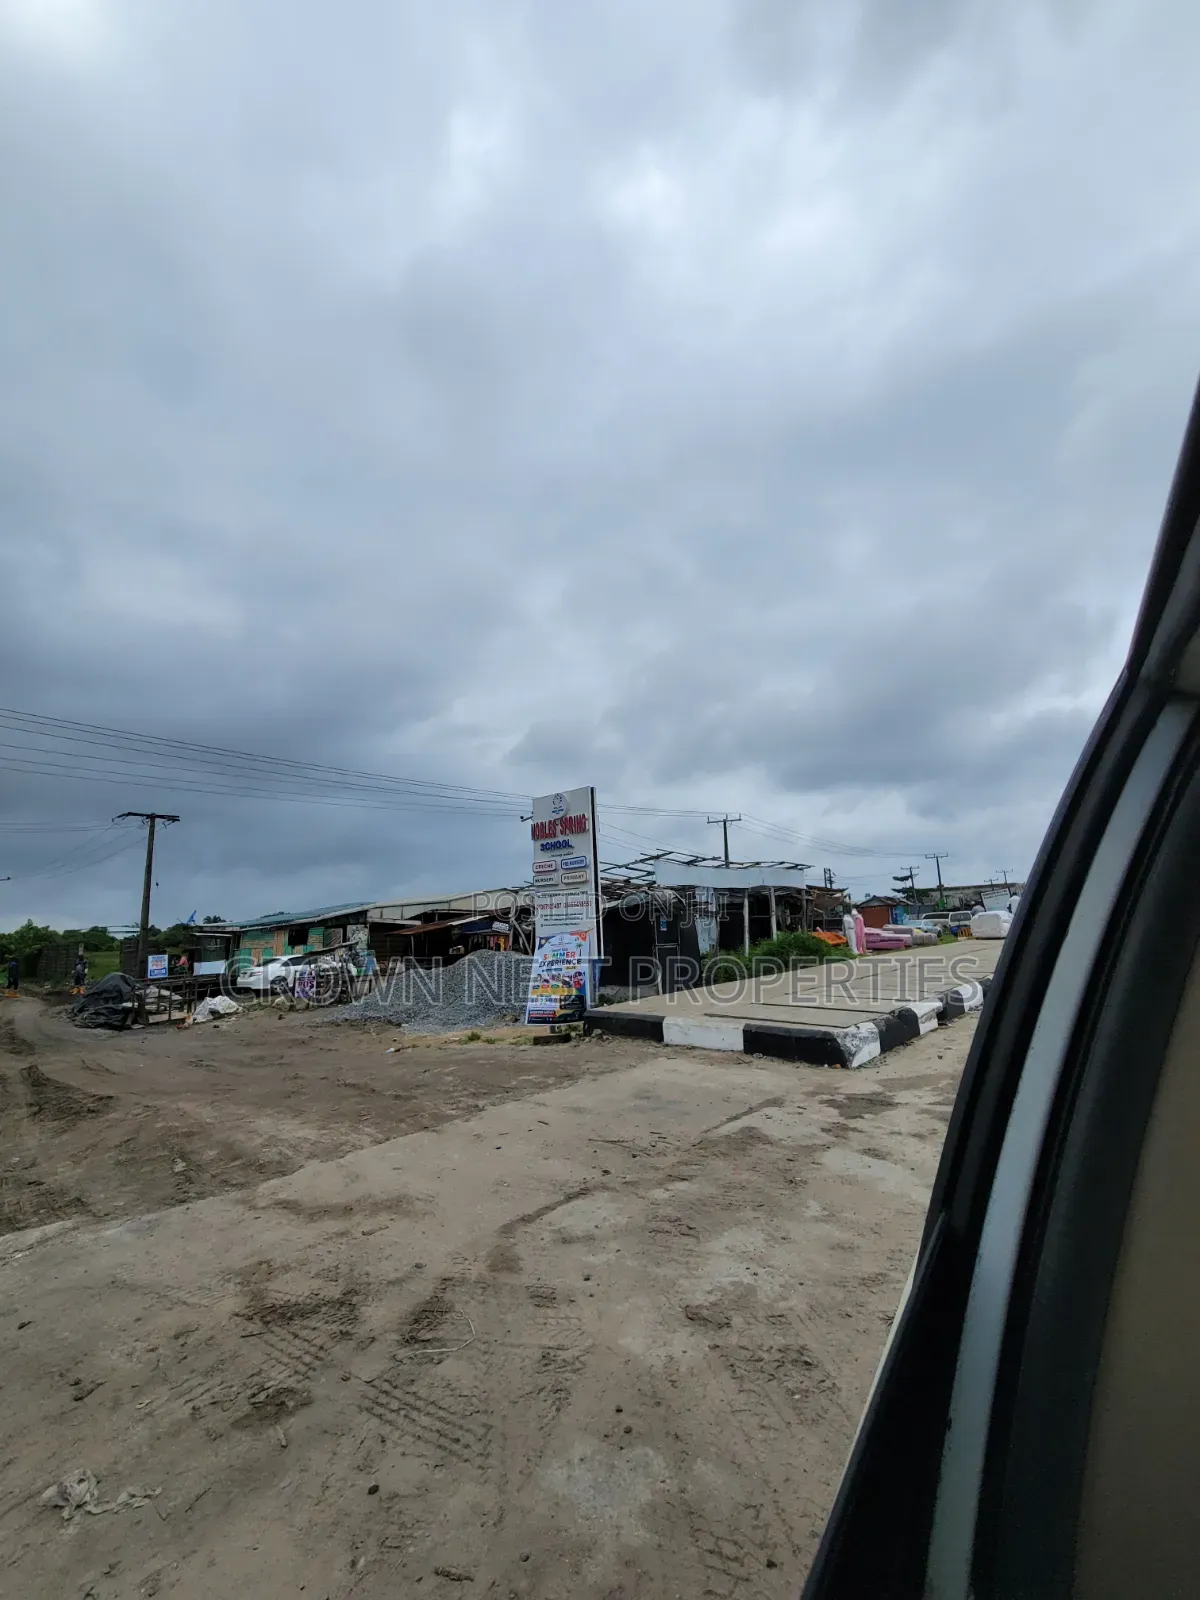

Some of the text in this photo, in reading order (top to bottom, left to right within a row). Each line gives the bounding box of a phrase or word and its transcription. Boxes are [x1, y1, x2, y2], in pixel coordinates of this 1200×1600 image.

[560, 813, 587, 836] SPRING
[540, 839, 573, 851] SCHOOL
[543, 951, 576, 960] SUMMER
[539, 958, 582, 968] EXPERIENCE
[298, 980, 315, 990] POS
